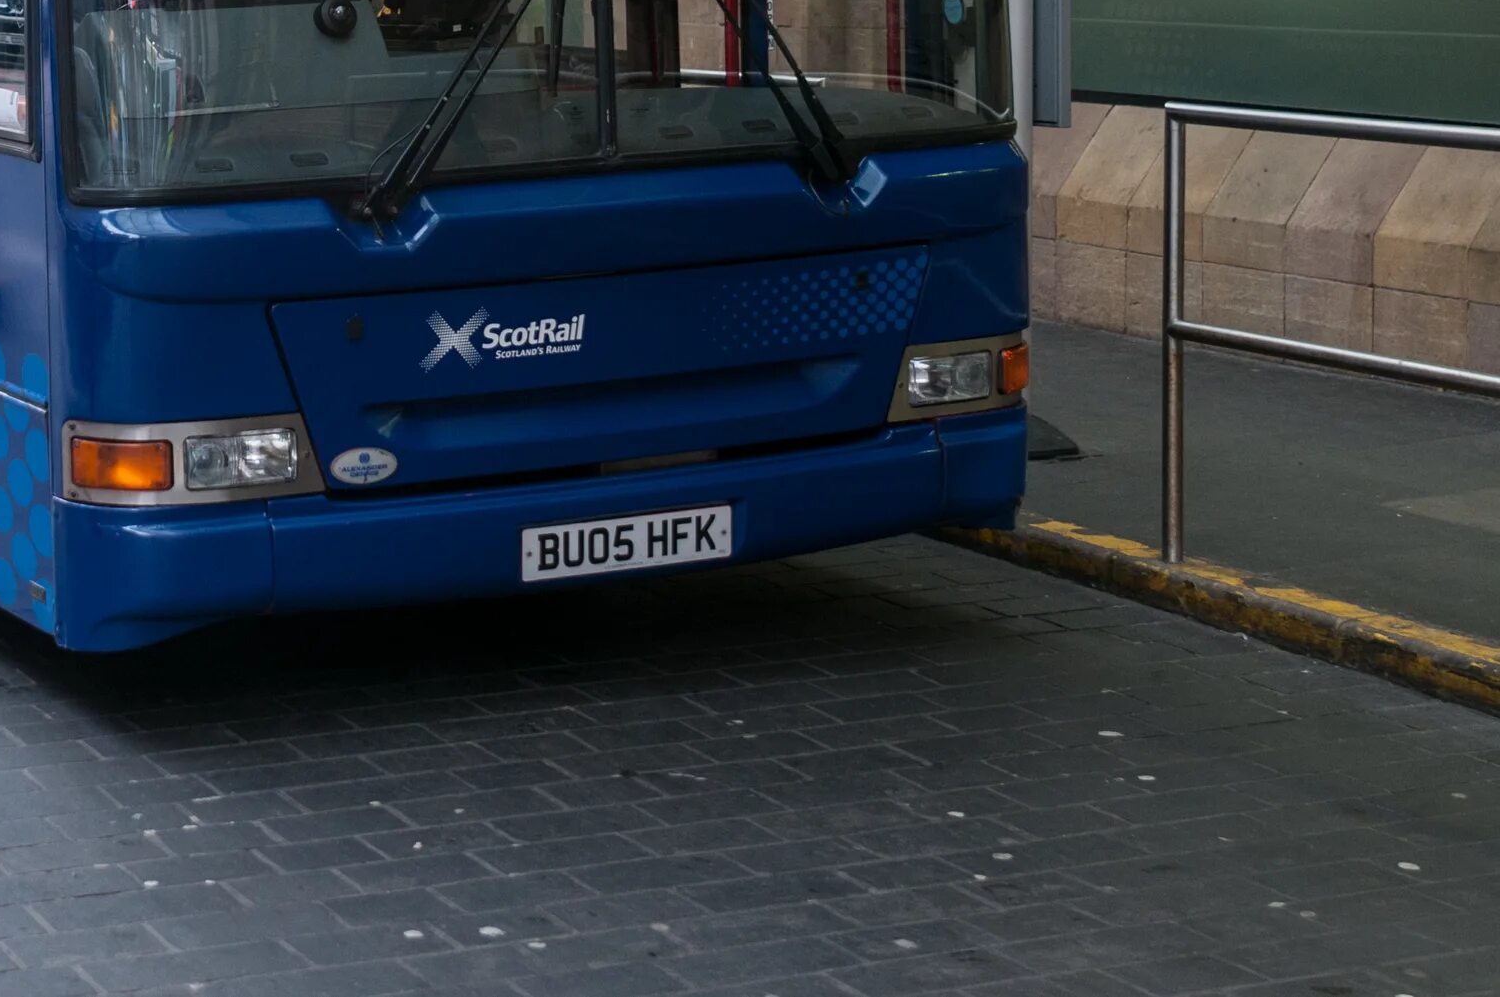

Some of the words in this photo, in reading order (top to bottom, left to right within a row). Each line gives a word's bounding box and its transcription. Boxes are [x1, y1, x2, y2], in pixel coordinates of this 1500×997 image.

[482, 314, 585, 349] ScotRail
[495, 346, 544, 359] SCOTLAND'S
[545, 344, 581, 354] RAILWAY
[537, 523, 634, 571] BU05
[647, 514, 716, 558] HFK
